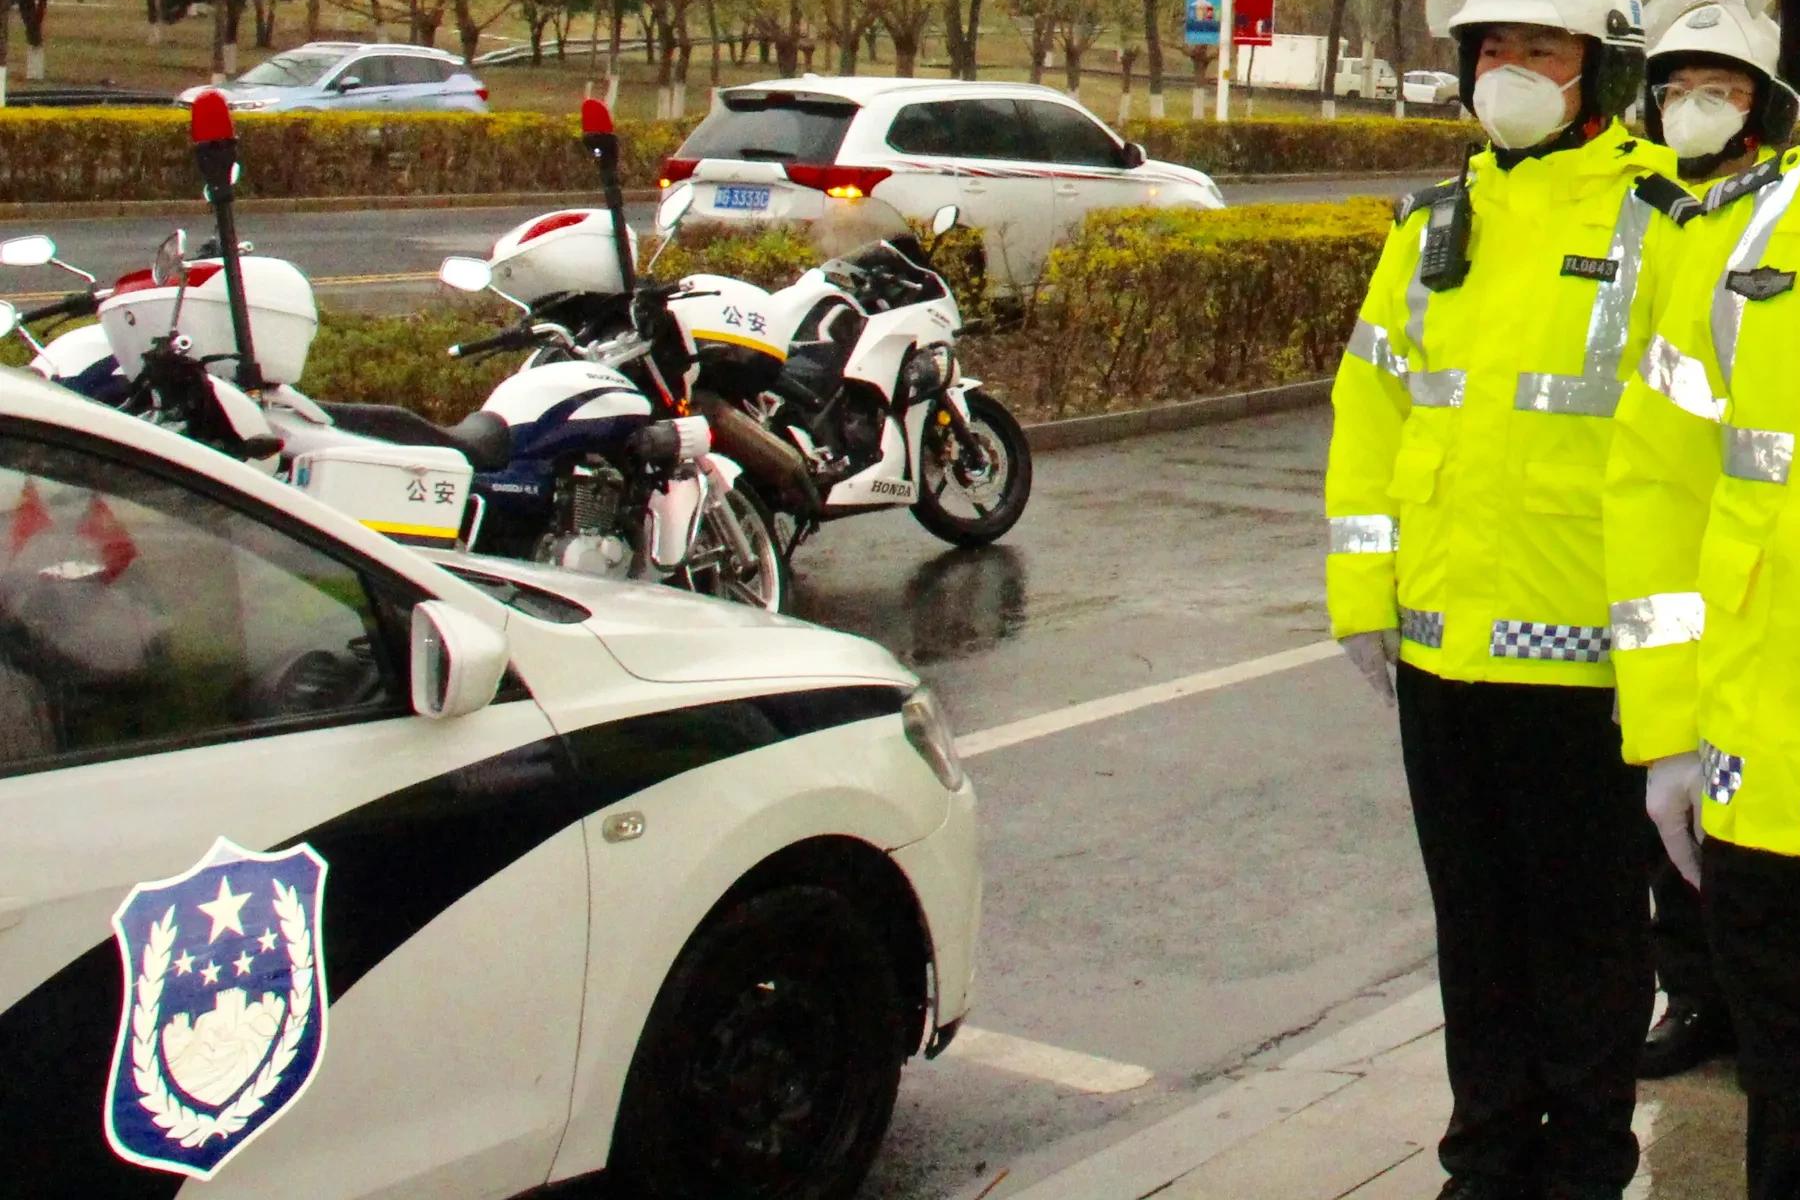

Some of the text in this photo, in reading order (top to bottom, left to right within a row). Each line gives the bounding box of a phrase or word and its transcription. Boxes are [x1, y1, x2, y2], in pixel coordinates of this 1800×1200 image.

[722, 305, 768, 335] 公安
[406, 479, 456, 504] 公安
[871, 480, 911, 497] HONDA
